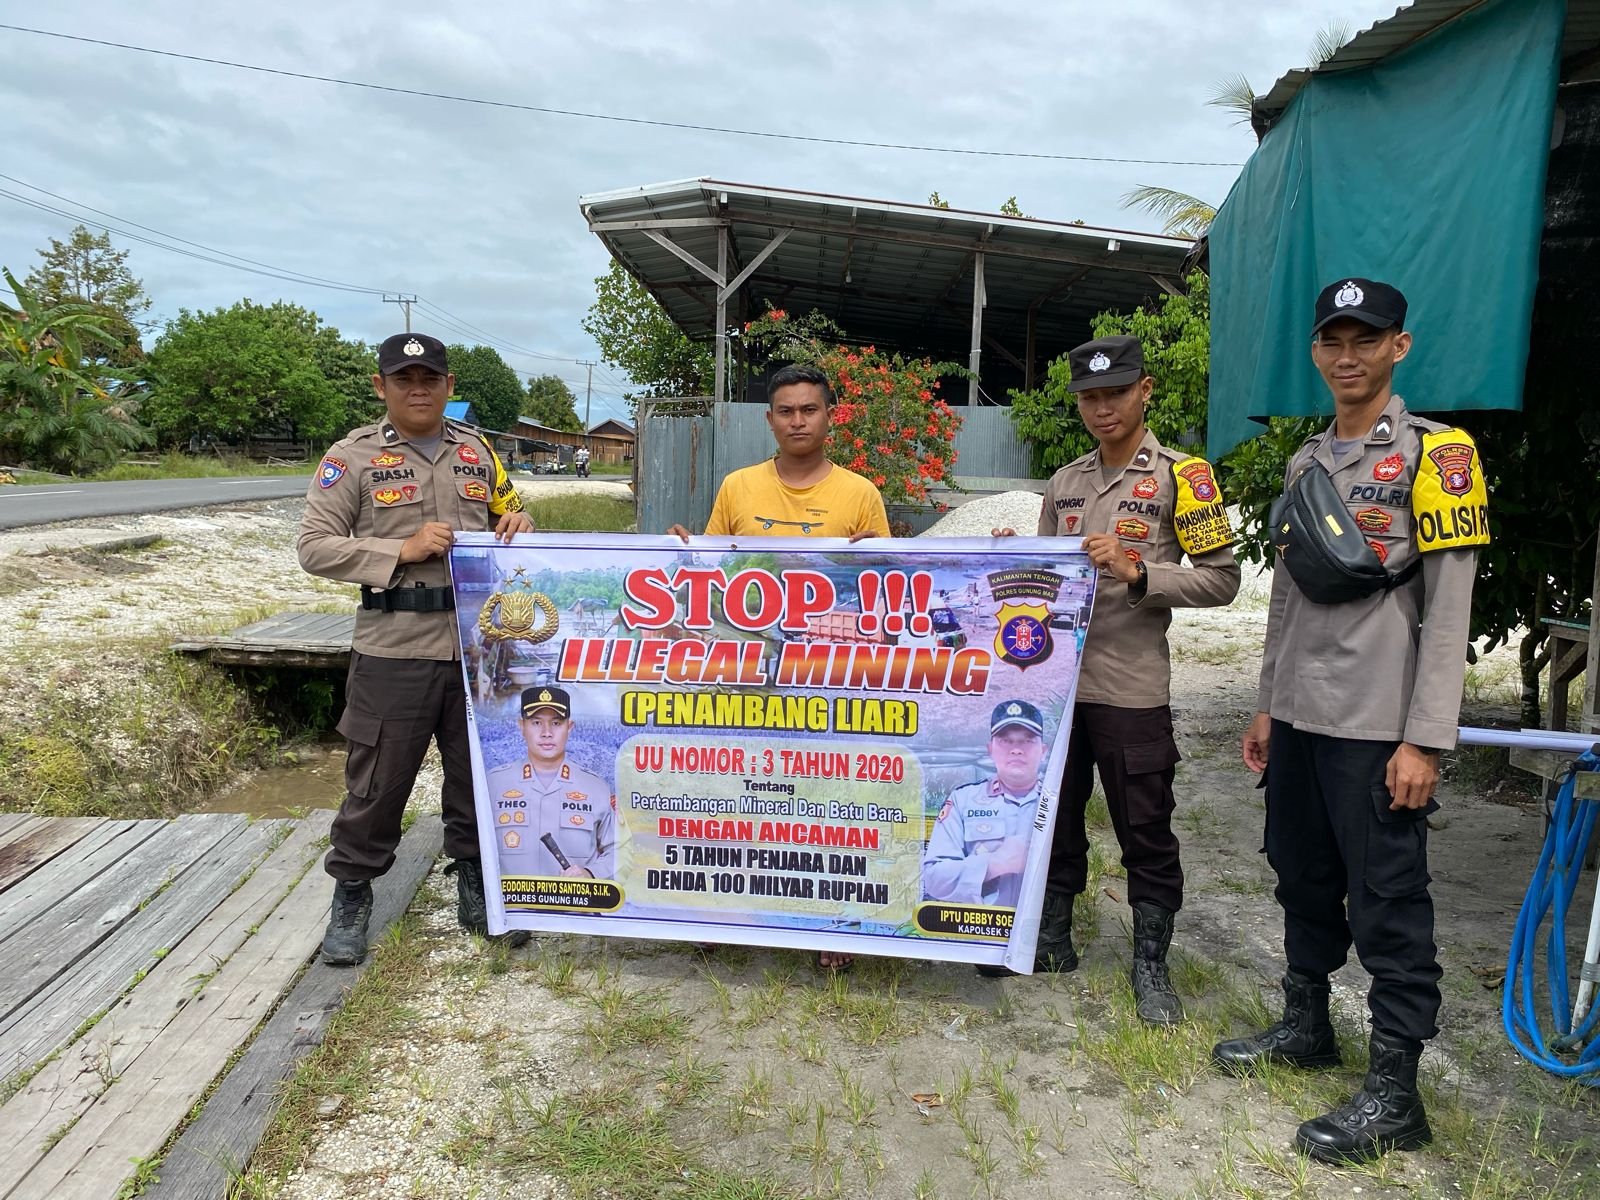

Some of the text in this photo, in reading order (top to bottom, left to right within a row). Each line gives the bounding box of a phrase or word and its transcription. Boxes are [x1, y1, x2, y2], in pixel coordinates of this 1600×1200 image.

[453, 466, 486, 477] POLRI
[1350, 485, 1409, 505] POLRI
[1118, 500, 1160, 516] POLRI
[1186, 521, 1212, 535] FOOD
[1189, 537, 1222, 552] POLSEK
[992, 574, 1060, 584] KALIMANTAN TENGAH
[995, 588, 1017, 597] POLRES
[1042, 590, 1055, 598] MAS
[620, 567, 934, 637] STOP !!!
[556, 638, 993, 696] ILLEGAL MINING
[621, 691, 919, 736] (PENAMBANG LIAR)
[634, 745, 664, 773] UU
[669, 745, 745, 775] NOMOR
[762, 748, 775, 775] 3
[780, 749, 850, 778] TAHUN
[855, 753, 905, 784] 2020
[743, 779, 795, 796] Tentang
[497, 800, 527, 809] THEO
[562, 802, 592, 812] POLRI
[631, 792, 908, 823] Pertambangan Mineral Dan Batu Bara.
[967, 808, 1000, 818] DEBBY
[1033, 796, 1049, 832] MINING
[657, 816, 880, 850] DENGAN ANCAMAN
[665, 845, 867, 877] 5 TAHUN PENJARA DAN
[536, 883, 558, 894] PRIYO
[559, 884, 592, 898] SANTOSA,
[593, 885, 611, 897] S.I.K.
[647, 868, 889, 905] DENDA 100 MILYAR RUPIAH
[538, 895, 571, 905] GUNUNG
[572, 897, 589, 906] MAS
[940, 909, 961, 923] IPTU
[963, 911, 994, 926] DEBBY
[958, 925, 1002, 937] KAPOLSEK
